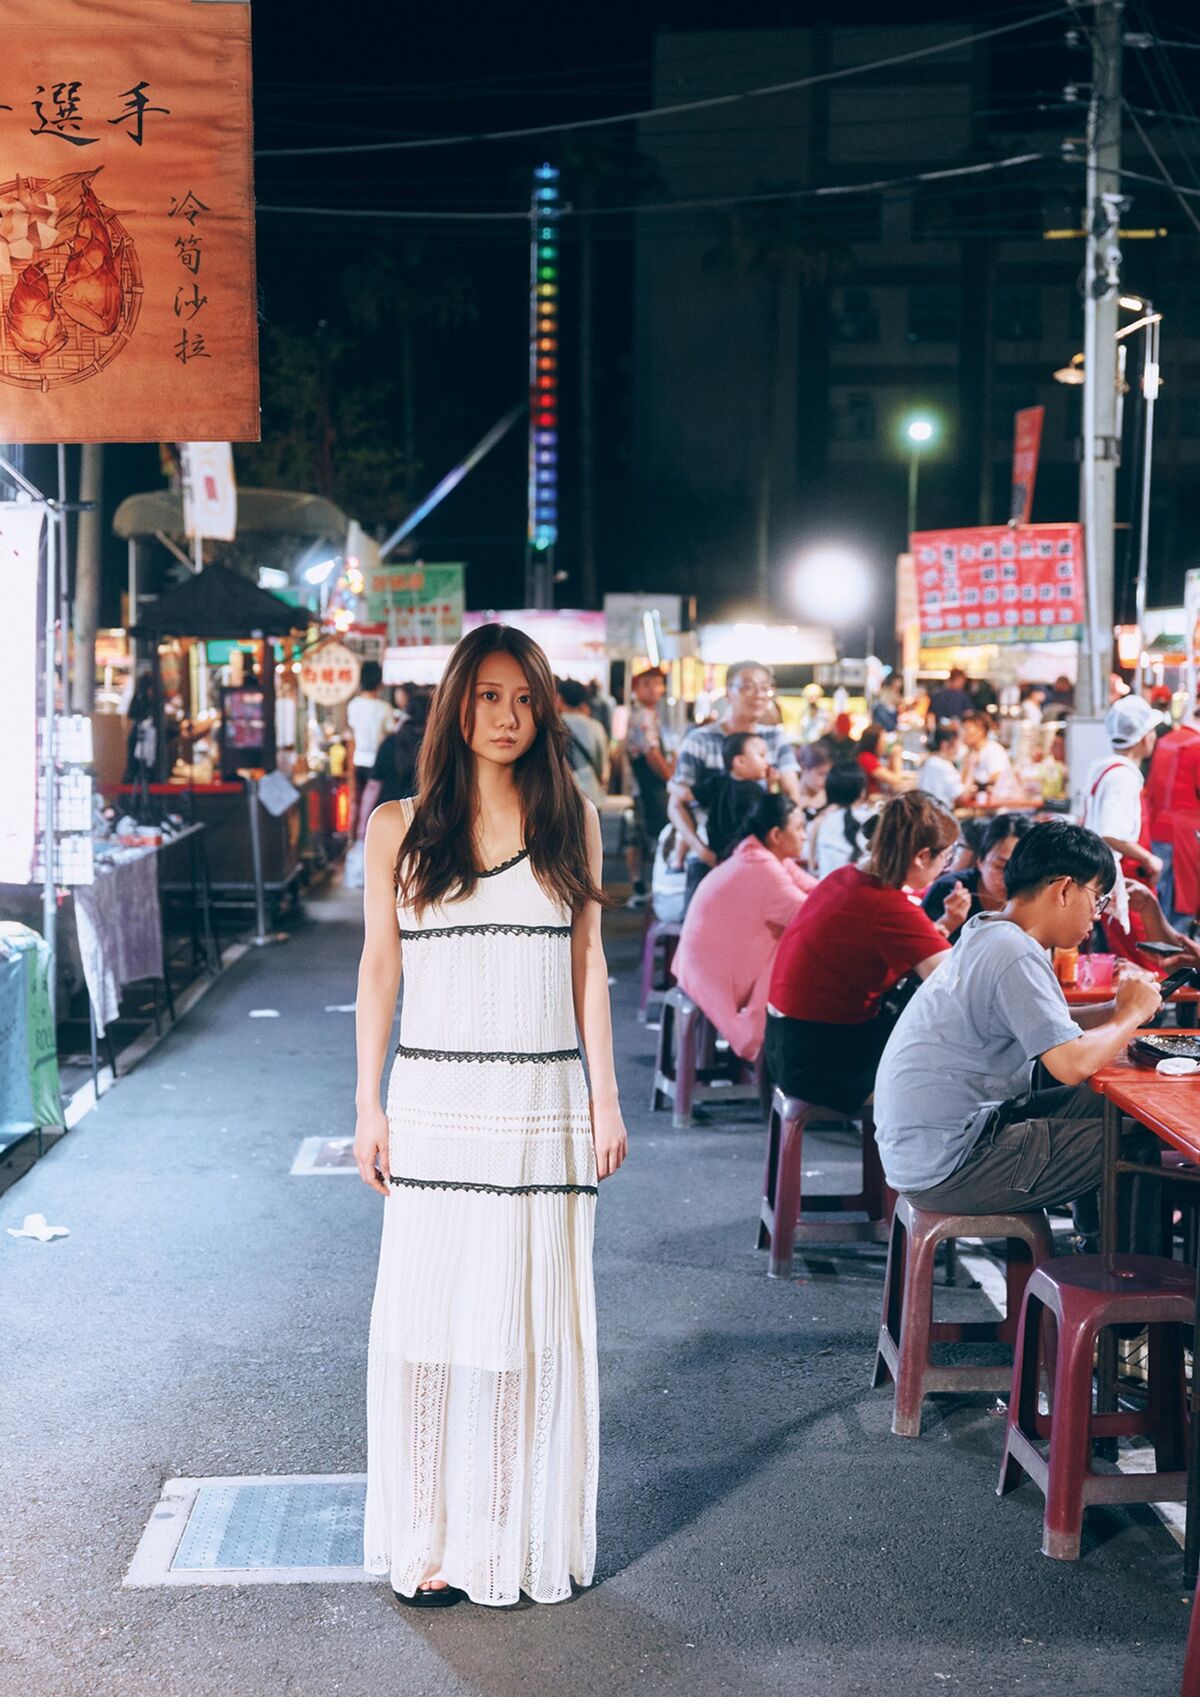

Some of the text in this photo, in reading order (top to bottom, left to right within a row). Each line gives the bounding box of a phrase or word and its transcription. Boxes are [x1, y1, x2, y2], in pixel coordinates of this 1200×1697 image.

[0, 81, 171, 147] 選手
[168, 190, 212, 365] 冷筍沙拉
